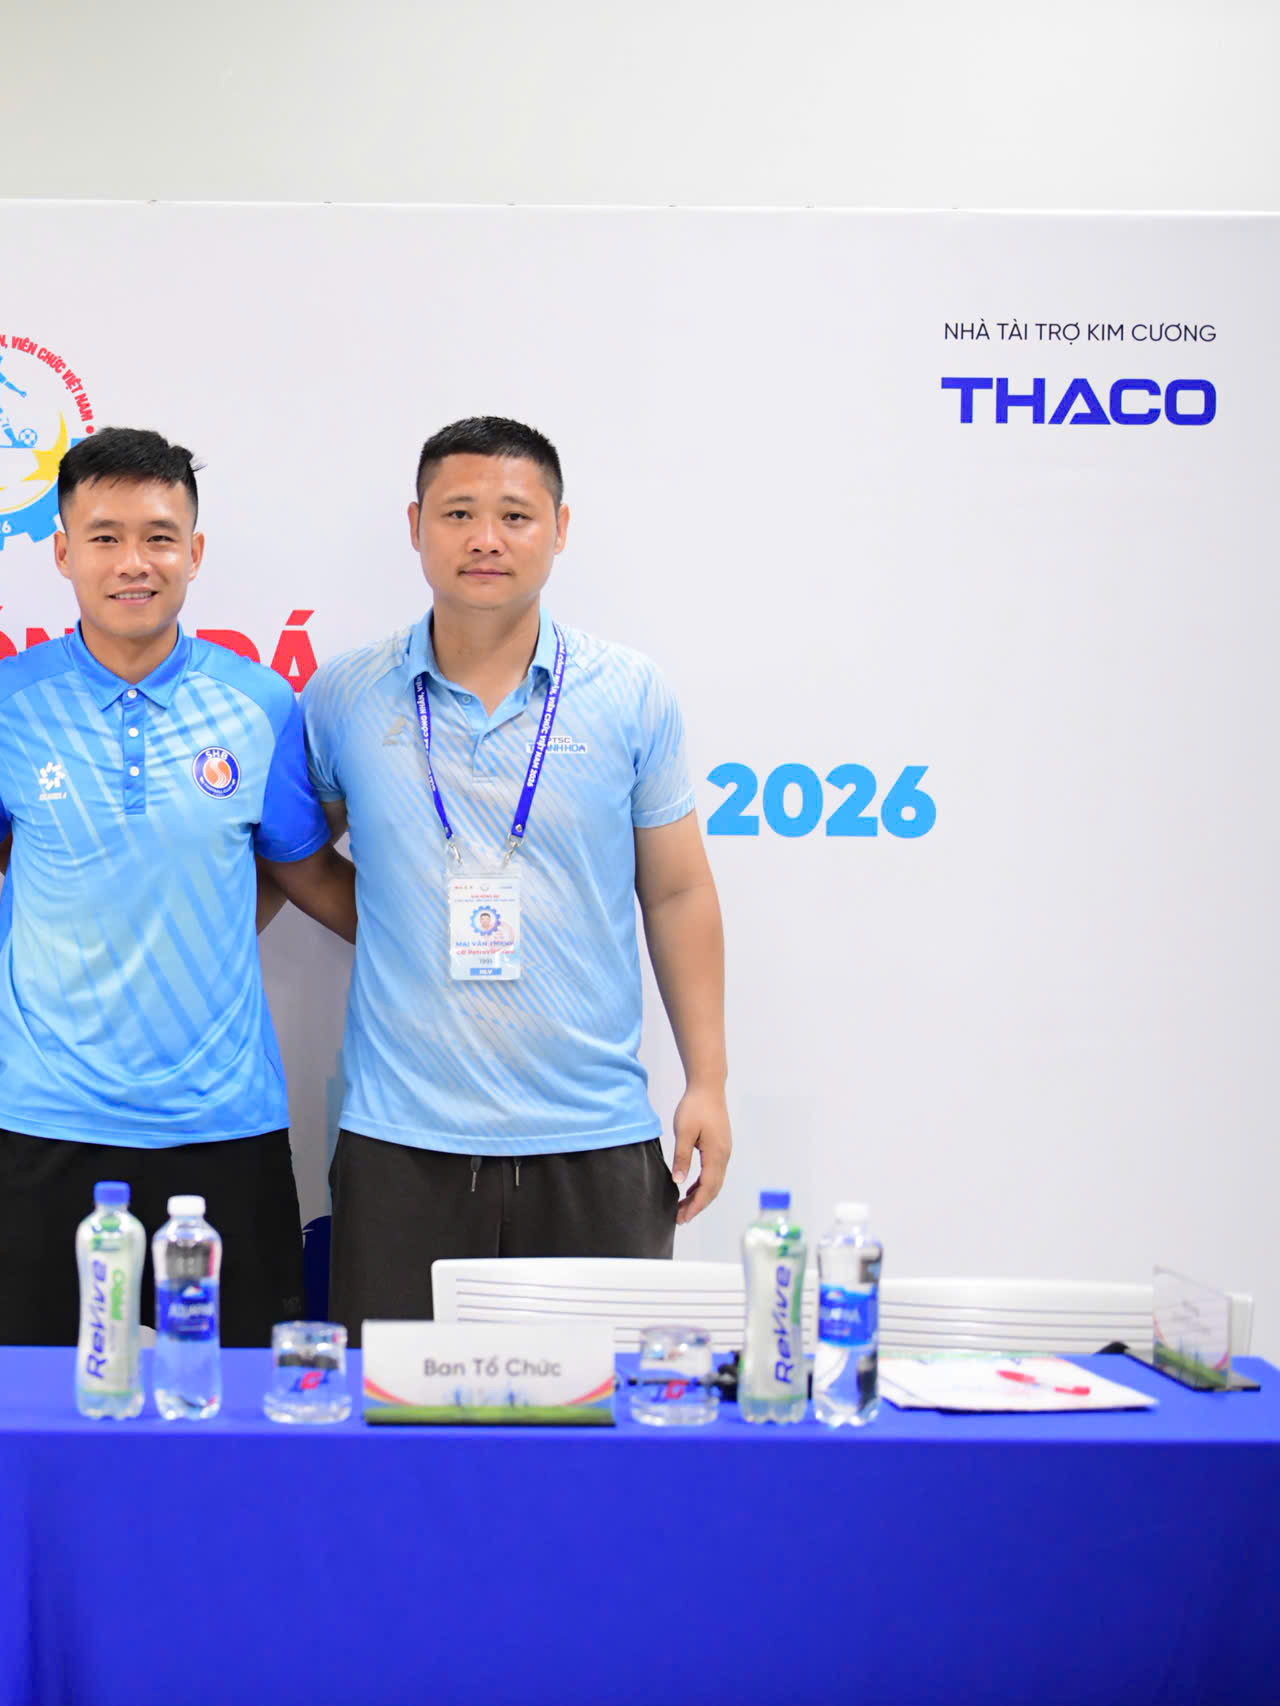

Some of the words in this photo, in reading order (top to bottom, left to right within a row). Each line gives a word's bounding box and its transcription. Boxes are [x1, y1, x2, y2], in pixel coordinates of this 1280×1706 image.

[944, 318, 990, 340] NHÀ
[997, 318, 1028, 340] TÀI
[1035, 322, 1080, 346] TRỢ
[1088, 323, 1124, 341] KIM
[1132, 322, 1217, 342] CƯƠNG
[11, 335, 38, 355] VIÊN
[36, 347, 67, 374] CHỨC
[62, 369, 83, 394] VIỆT
[74, 393, 93, 422] NAM
[941, 377, 1217, 425] THACO
[205, 750, 228, 760] SHB
[707, 762, 936, 839] 2026
[424, 1359, 466, 1376] Ban
[472, 1354, 499, 1376] Tổ
[505, 1357, 562, 1377] Chức
